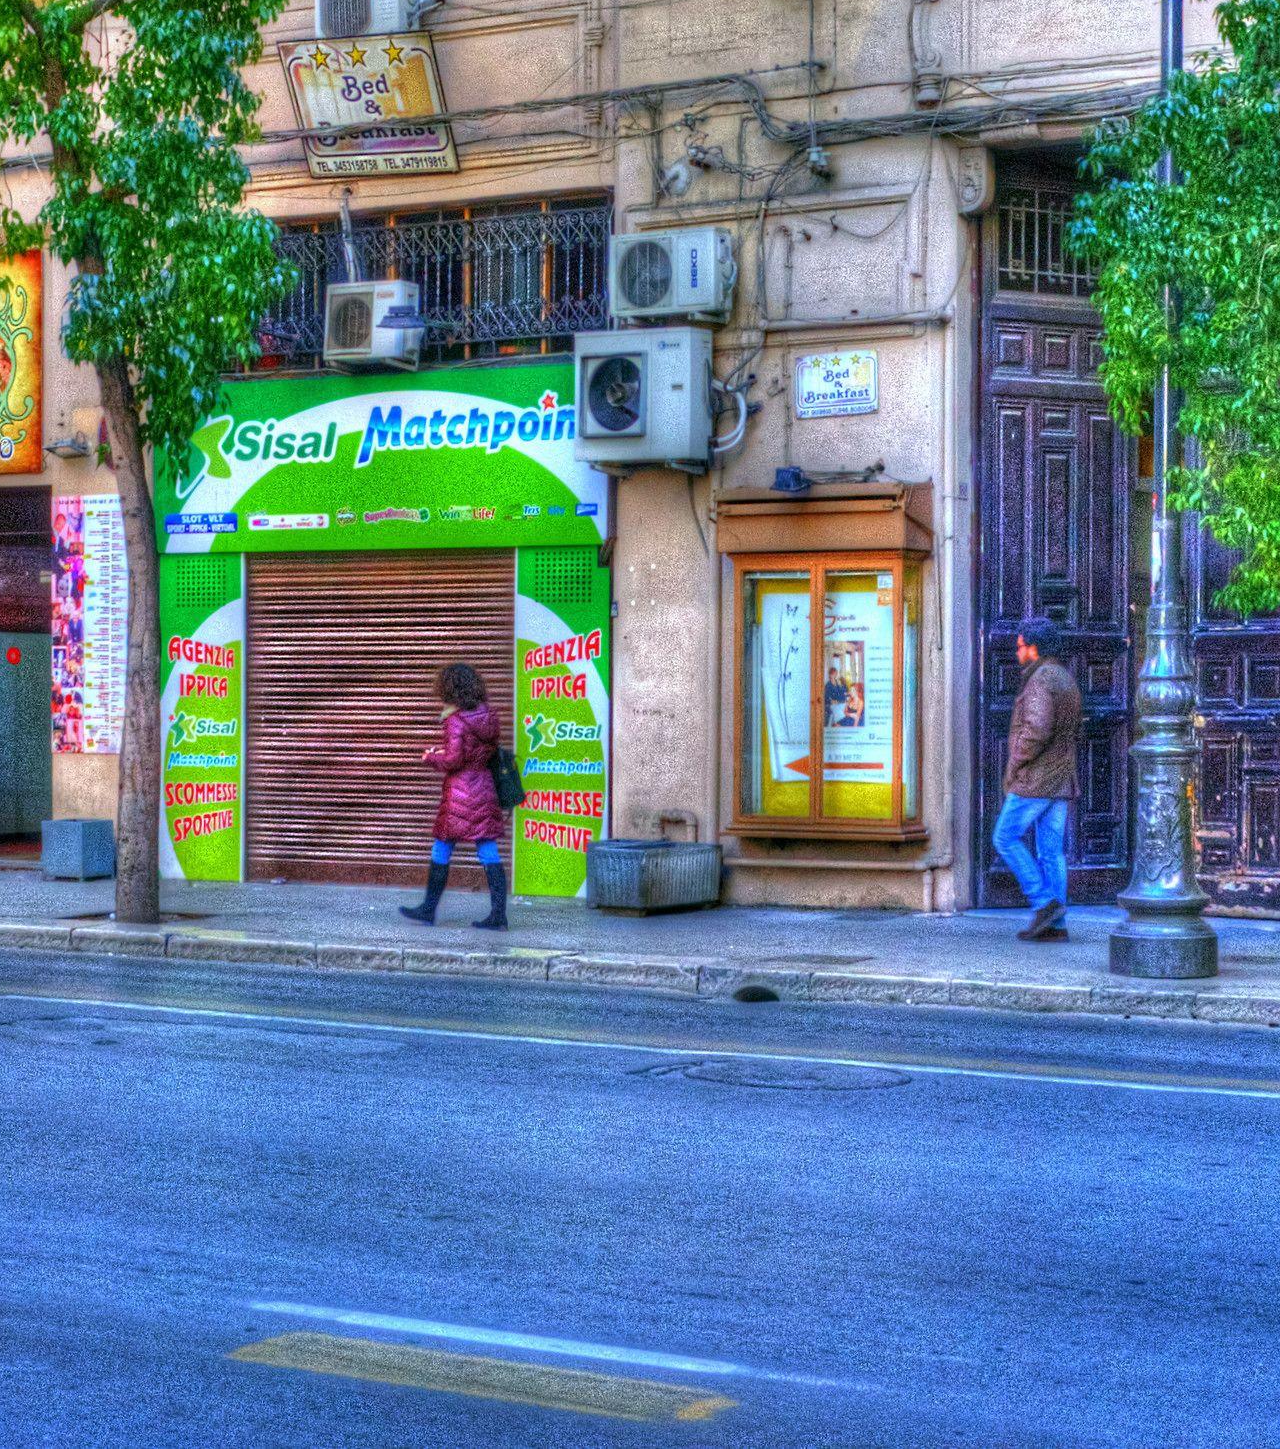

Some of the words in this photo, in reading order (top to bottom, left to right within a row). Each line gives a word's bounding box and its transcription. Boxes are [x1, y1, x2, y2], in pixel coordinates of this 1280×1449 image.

[342, 74, 390, 101] Bed
[365, 99, 382, 116] &
[823, 369, 849, 382] Bed
[805, 388, 869, 403] Breakfast
[235, 422, 337, 461] Sisal
[358, 398, 575, 463] Matchpoin
[182, 515, 201, 523] SLOT
[208, 514, 224, 523] VLT
[473, 507, 495, 520] Life!
[169, 637, 234, 669] AGENZIA
[525, 629, 601, 671] AGENZIA
[180, 674, 228, 699] IPPICA
[531, 673, 587, 700] IPPICA
[196, 720, 236, 734] Sisal
[556, 724, 601, 740] Sisal
[168, 752, 237, 770] Matchpoint
[523, 758, 602, 776] Matchpoint
[165, 782, 237, 807] SCOMMESSE
[173, 810, 233, 843] SPORTIVE
